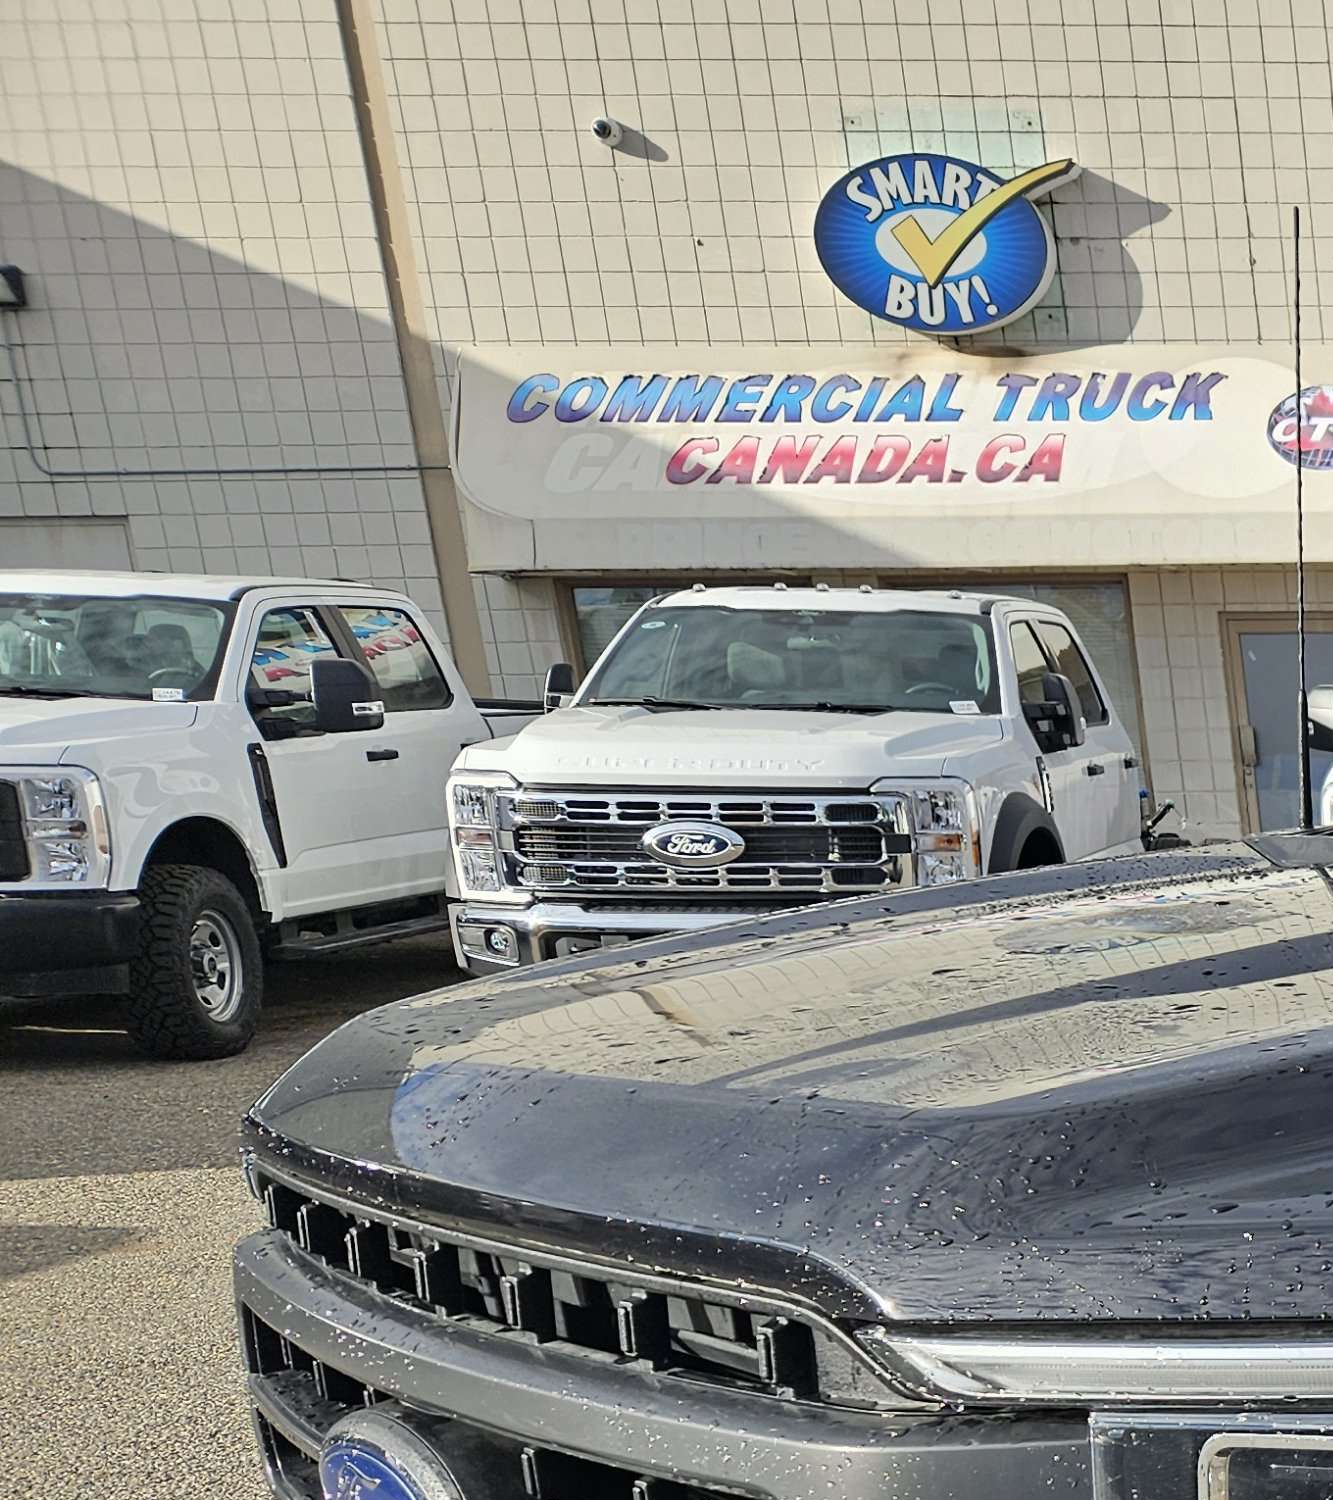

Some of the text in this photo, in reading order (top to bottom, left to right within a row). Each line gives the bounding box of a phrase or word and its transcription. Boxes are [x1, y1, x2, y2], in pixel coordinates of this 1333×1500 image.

[846, 160, 1002, 222] SMART
[885, 275, 998, 326] BUY!
[506, 371, 1228, 423] COMMERCIAL TRUCK
[665, 432, 1067, 484] CANADA.CA
[666, 833, 718, 854] Ford
